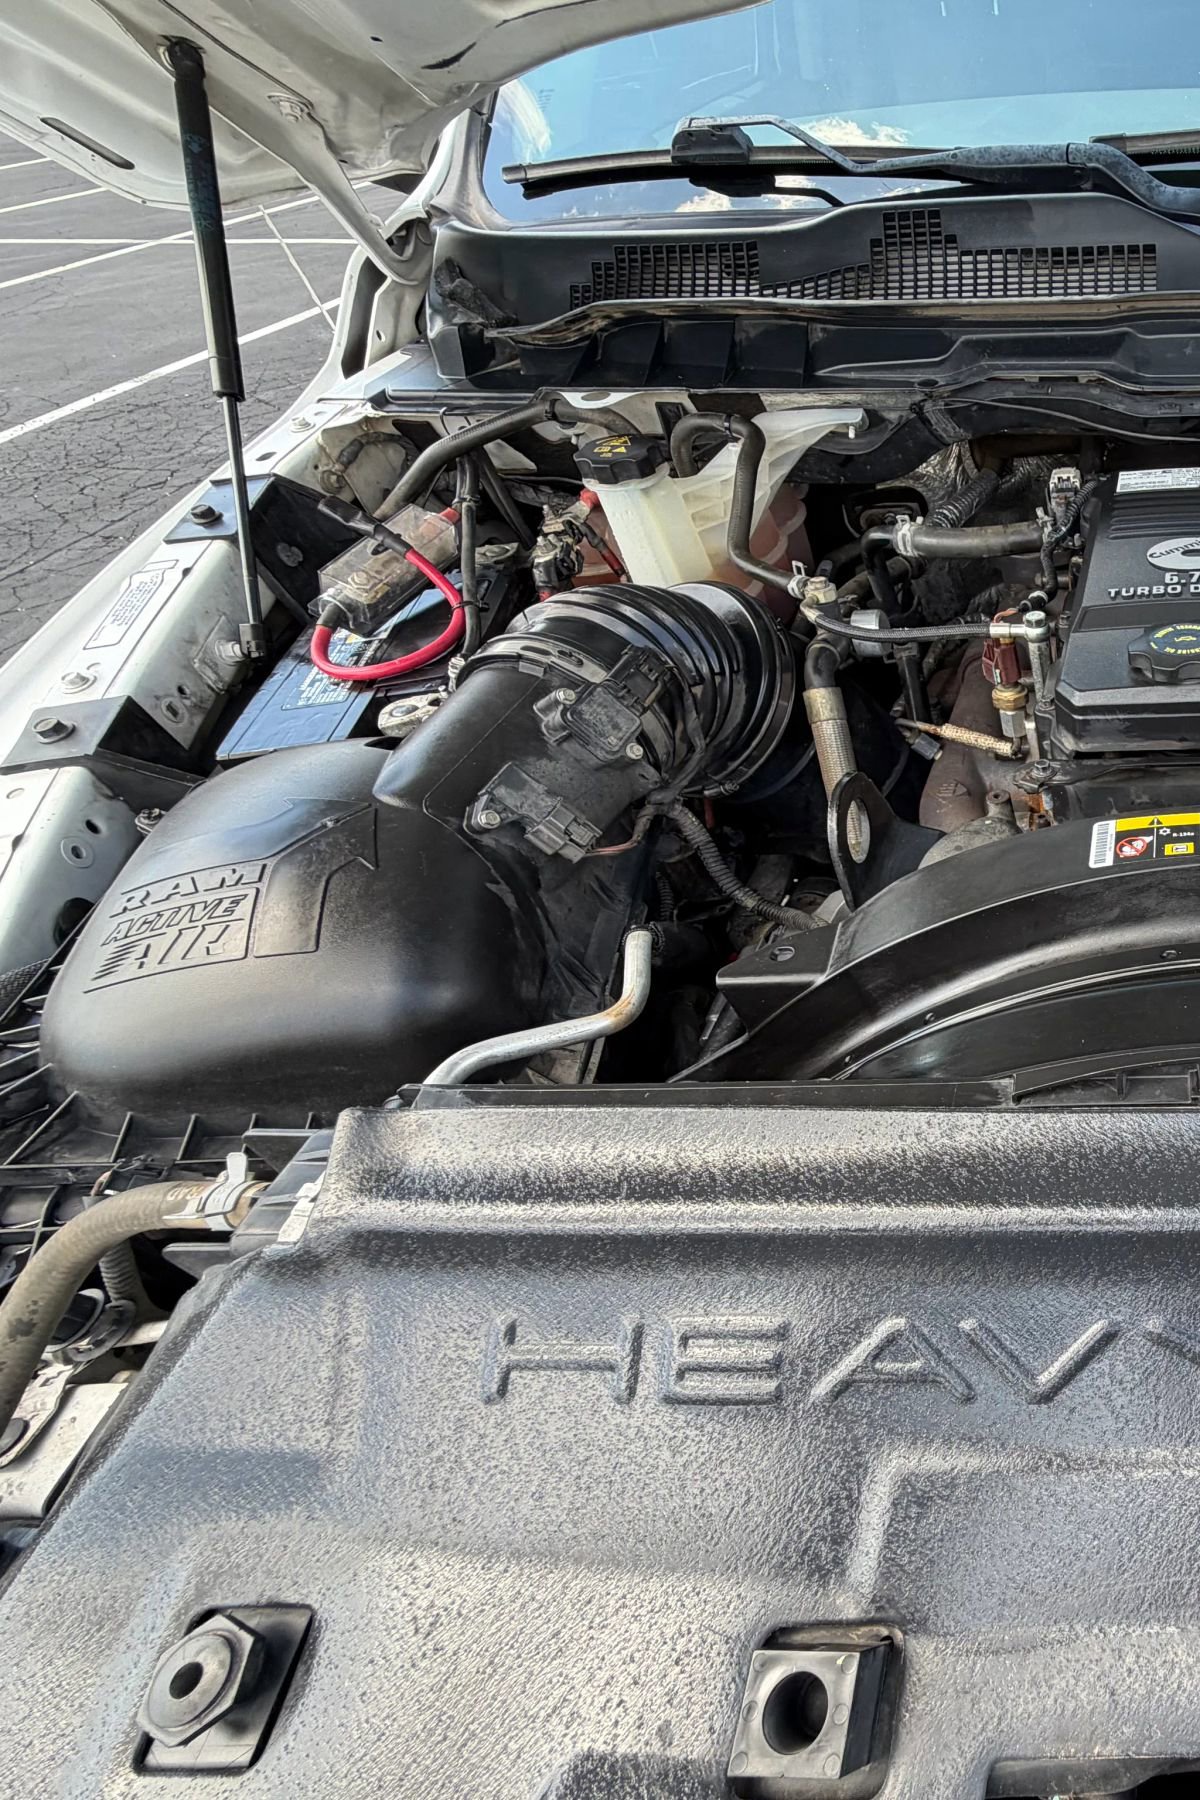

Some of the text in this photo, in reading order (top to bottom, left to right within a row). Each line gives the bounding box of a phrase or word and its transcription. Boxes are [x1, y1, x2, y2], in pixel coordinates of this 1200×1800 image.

[1107, 584, 1182, 598] TURBO
[110, 863, 267, 919] RAM
[100, 893, 250, 947] ACTIVE
